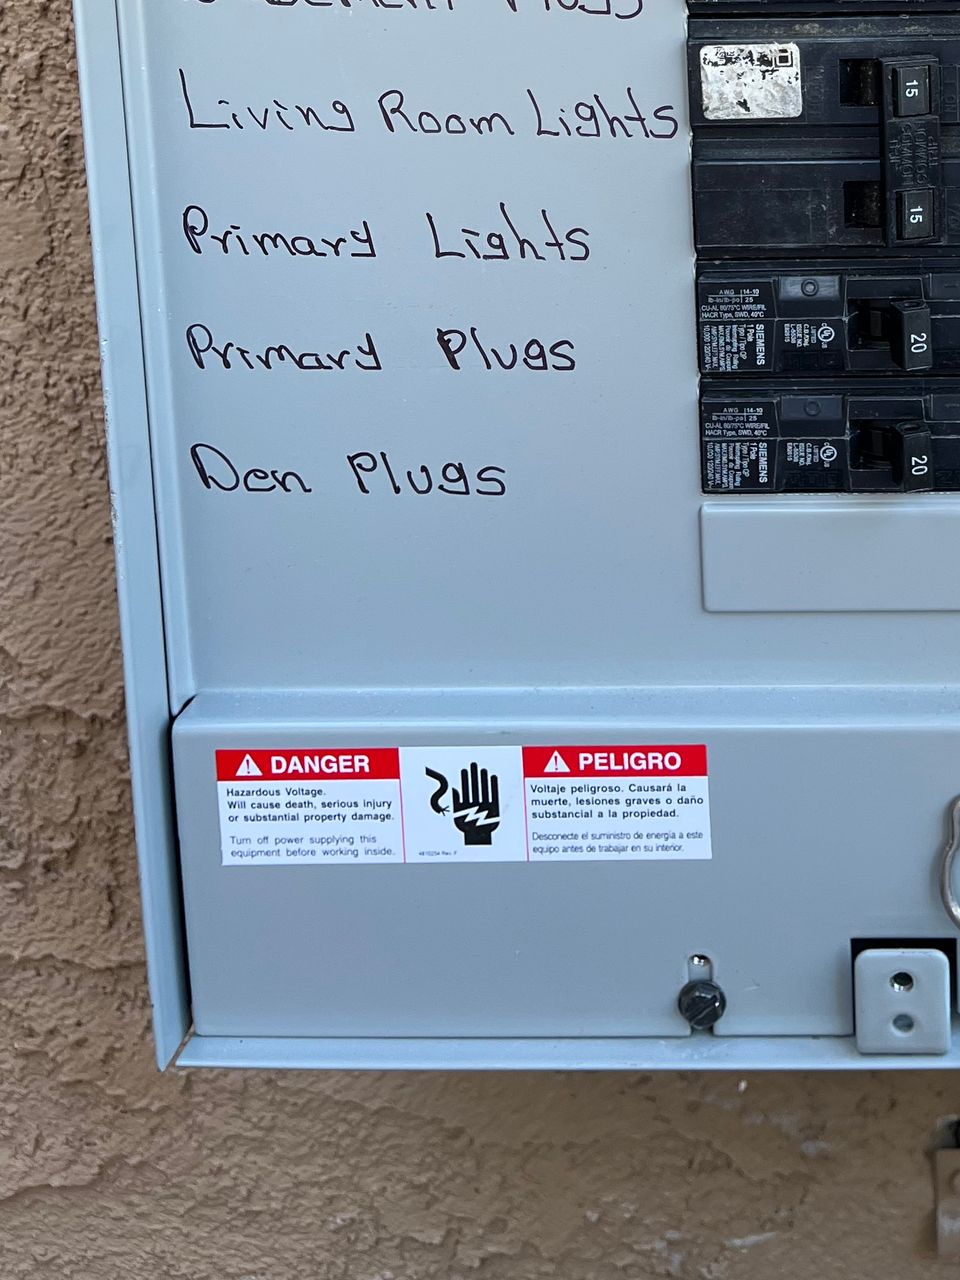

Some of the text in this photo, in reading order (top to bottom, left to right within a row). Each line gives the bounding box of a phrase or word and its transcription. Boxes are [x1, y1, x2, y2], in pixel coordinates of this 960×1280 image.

[905, 78, 919, 98] 15
[178, 68, 680, 139] Living Room Lights
[909, 204, 923, 224] 15
[181, 201, 591, 261] Primary Lights
[186, 322, 577, 372] Primary Plugs
[755, 322, 766, 367] SIEMENS
[910, 332, 928, 354] 20
[190, 442, 507, 496] Den Plugs
[758, 441, 769, 484] SIEMENS
[911, 454, 928, 476] 20
[270, 754, 370, 774] DANGER
[578, 751, 682, 771] PELIGRO
[226, 787, 326, 798] Hazardous Voltage.
[530, 782, 687, 795] Voltaje peligroso. Causará la
[227, 800, 247, 809] Will
[285, 800, 317, 810] death,
[320, 799, 359, 808] serious
[362, 799, 392, 810] injury
[530, 795, 704, 807] muerte, lesiones graves o daño
[228, 812, 395, 823] or substantial property damage.
[531, 808, 680, 820] substancial a la propiedad.
[230, 834, 377, 846] Turn off power supplying this
[531, 831, 579, 841] Desconecte
[581, 831, 589, 840] el
[590, 831, 632, 840] suministro
[633, 831, 644, 840] de
[646, 830, 677, 842] energía
[686, 831, 704, 840] este
[230, 846, 396, 858] equipment before working inside.
[532, 843, 685, 856] equipo antes de trabajar en su interior.
